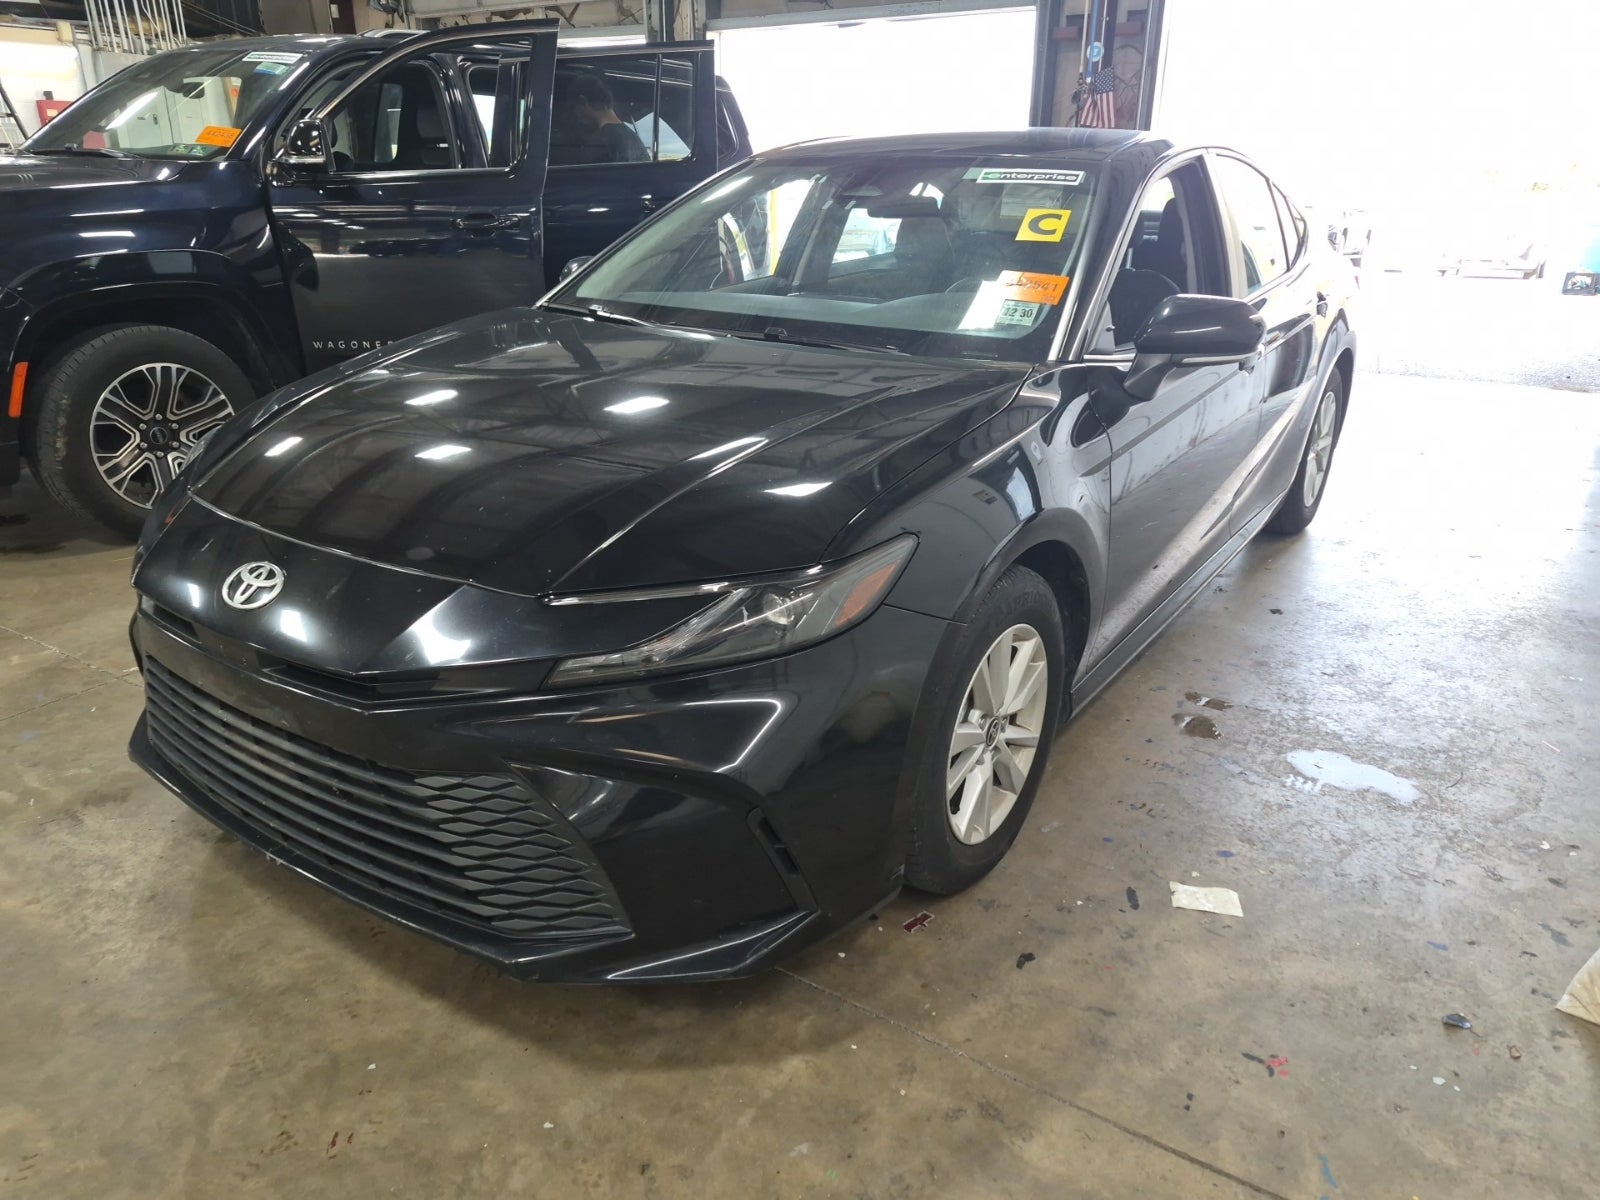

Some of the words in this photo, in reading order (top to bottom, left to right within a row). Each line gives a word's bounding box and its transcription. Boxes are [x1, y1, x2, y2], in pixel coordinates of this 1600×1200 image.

[984, 173, 1078, 181] enterprise
[1028, 213, 1062, 236] C
[1003, 307, 1017, 317] 12
[1019, 308, 1033, 319] 30
